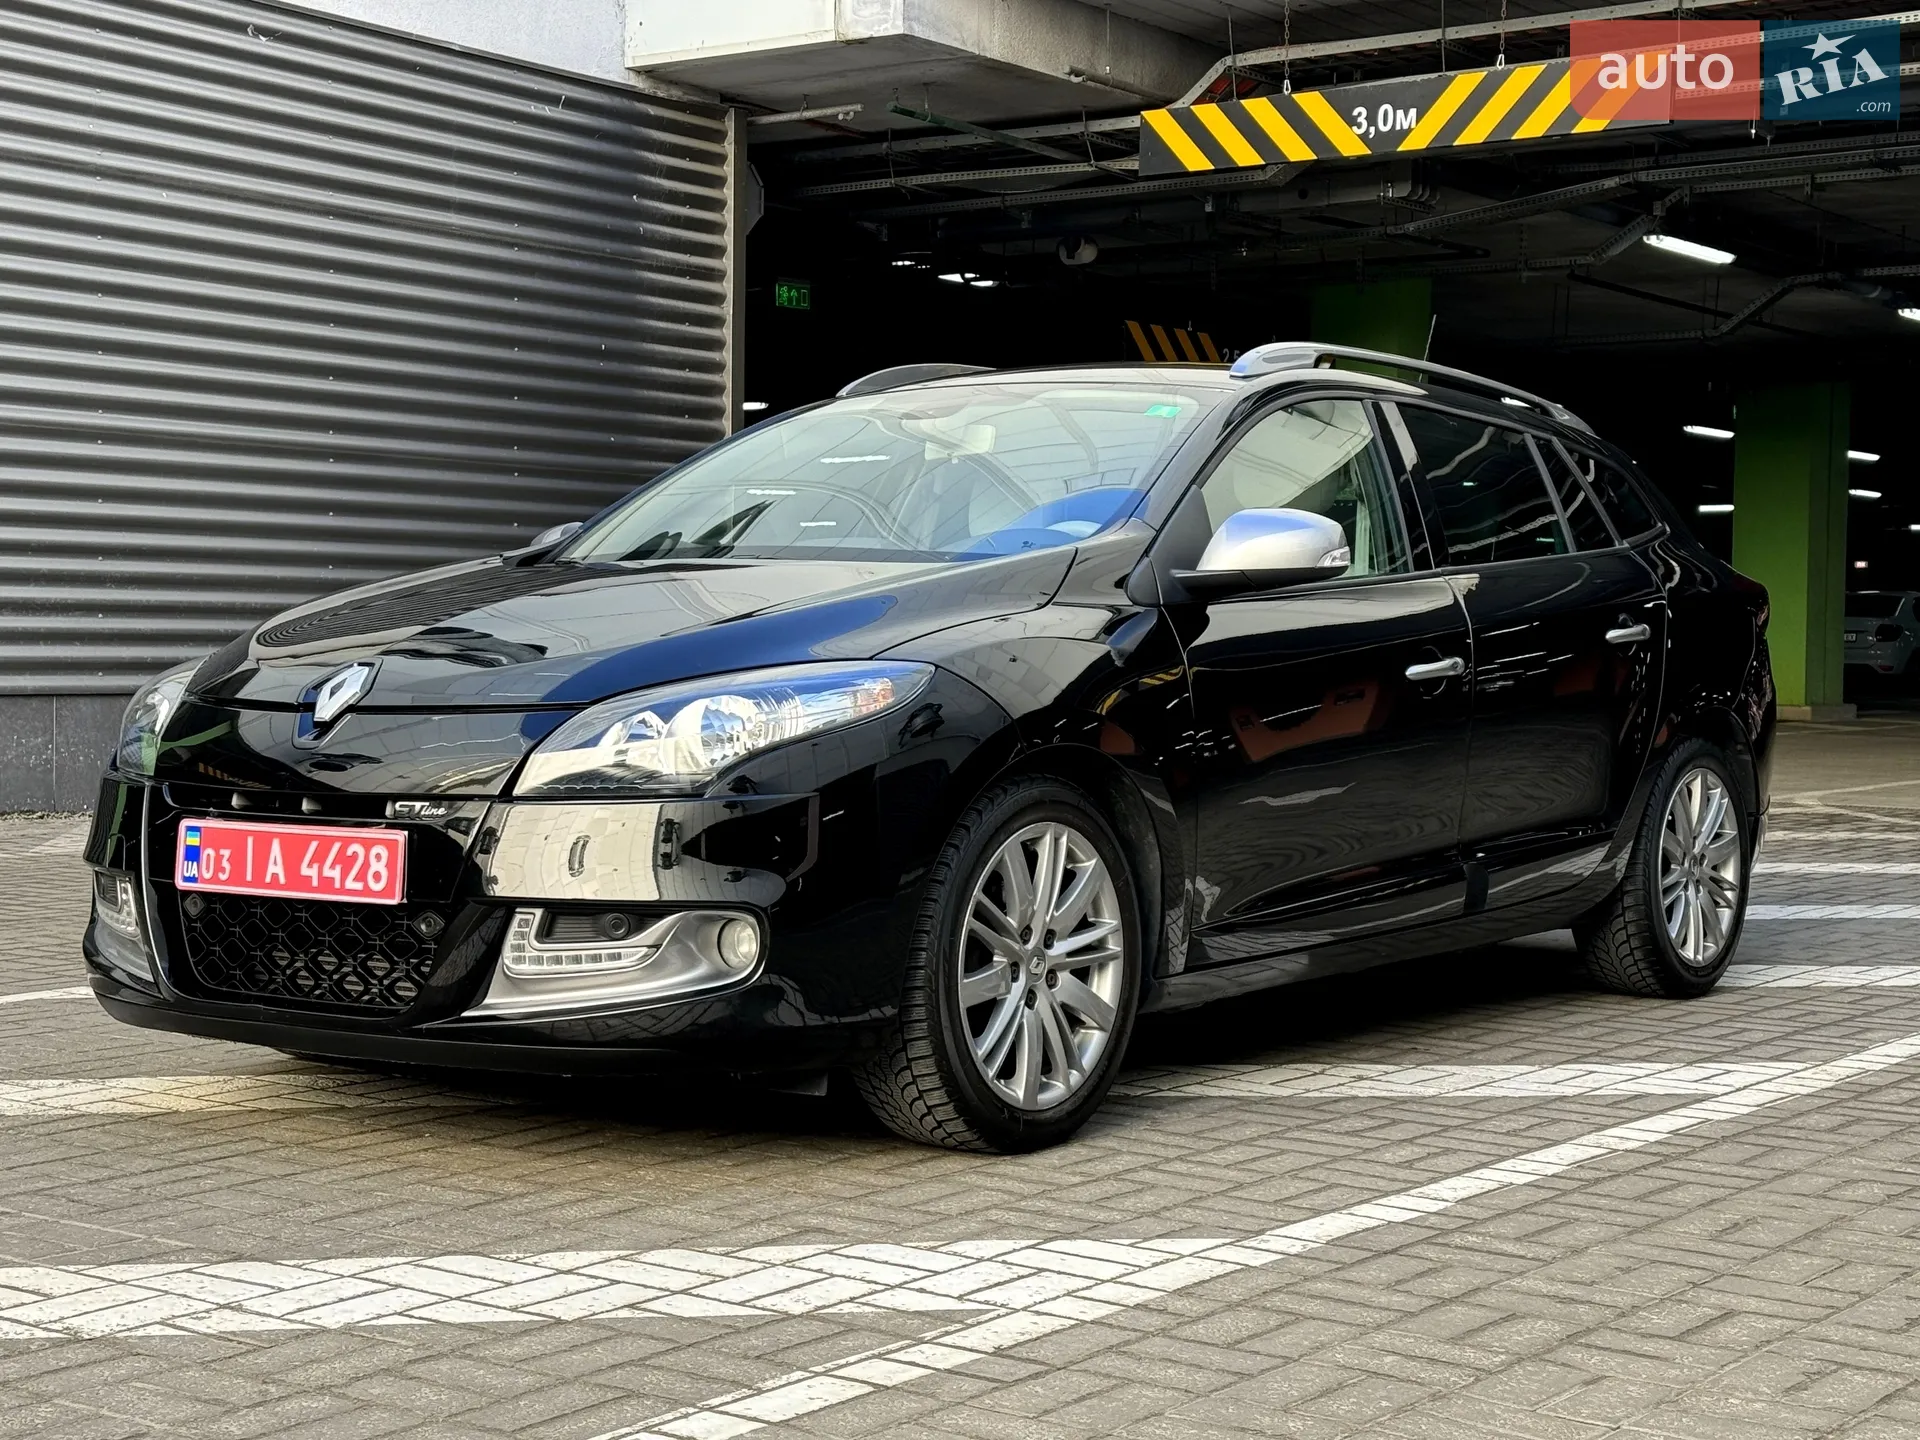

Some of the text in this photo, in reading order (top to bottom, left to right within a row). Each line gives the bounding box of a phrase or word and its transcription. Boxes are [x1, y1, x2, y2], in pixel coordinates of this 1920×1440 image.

[183, 861, 199, 878] UA
[201, 847, 232, 881] 03
[300, 840, 389, 892] 4428
